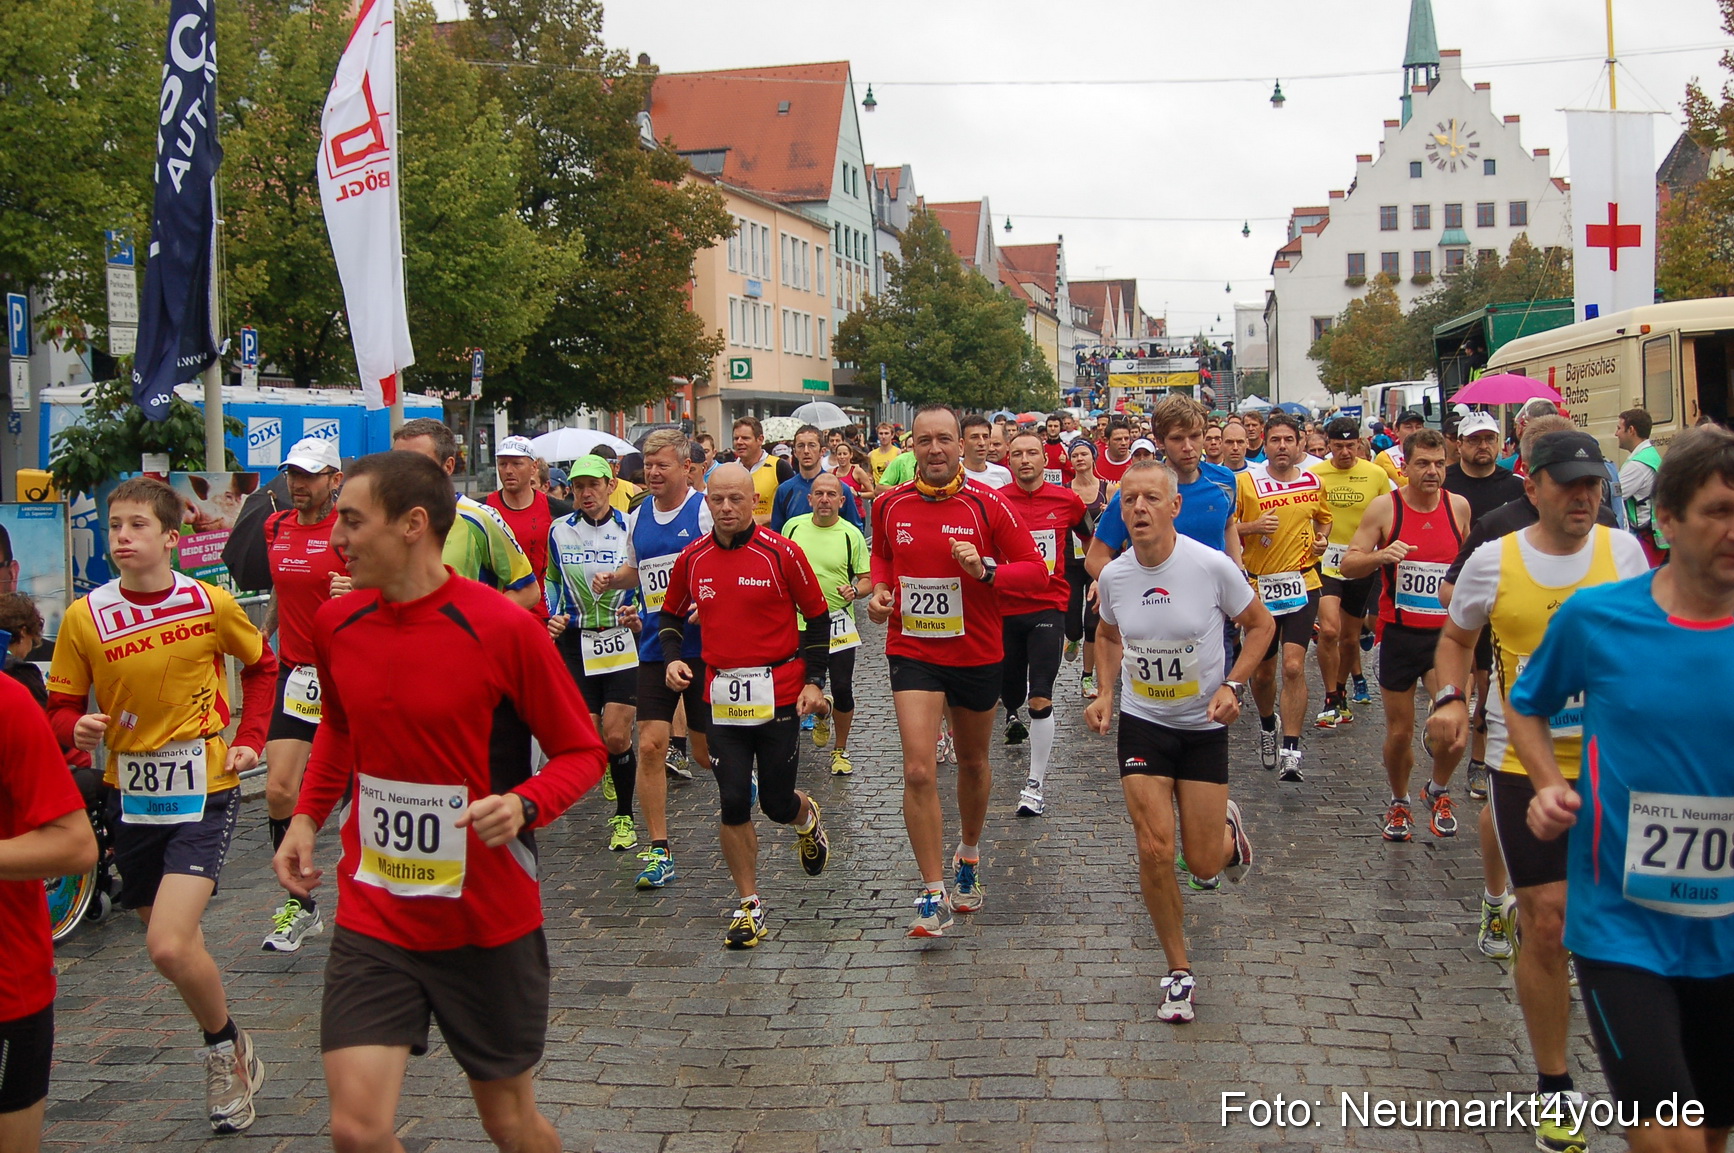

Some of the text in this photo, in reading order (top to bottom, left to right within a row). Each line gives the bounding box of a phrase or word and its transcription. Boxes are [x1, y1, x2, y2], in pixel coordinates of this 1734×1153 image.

[733, 361, 748, 377] D
[1566, 357, 1615, 383] Bayerisches
[1138, 376, 1168, 384] START
[1566, 386, 1589, 405] Rotes
[1044, 473, 1061, 482] 2138
[1260, 499, 1289, 511] MAX
[942, 525, 974, 535] Markus
[181, 541, 227, 556] BEIDE STIM
[653, 559, 675, 568] Neumark
[1331, 554, 1340, 567] 4
[738, 576, 771, 587] Robert
[918, 582, 949, 591] Neumarkt
[1263, 581, 1301, 600] 2980
[910, 592, 949, 615] 228
[1142, 597, 1171, 606] skinfit
[915, 619, 946, 630] Markus
[104, 622, 216, 663] MAX BÖGL
[593, 636, 625, 656] 556
[1127, 643, 1182, 655] PARTL Neumarkt
[1137, 657, 1183, 681] 314
[729, 680, 751, 702] 91
[1148, 687, 1175, 698] David
[296, 703, 321, 715] Reinh
[728, 707, 755, 718] Robert
[1548, 713, 1584, 726] Ludwi
[146, 748, 188, 758] Neumarkt
[127, 760, 195, 792] 2871
[361, 785, 444, 808] PARTL Neumarkt
[147, 801, 179, 812] Jonas
[1632, 803, 1734, 821] PARTL Neumar
[373, 806, 440, 854] 390
[378, 857, 435, 881] Matthias
[1670, 882, 1719, 900] Klaus
